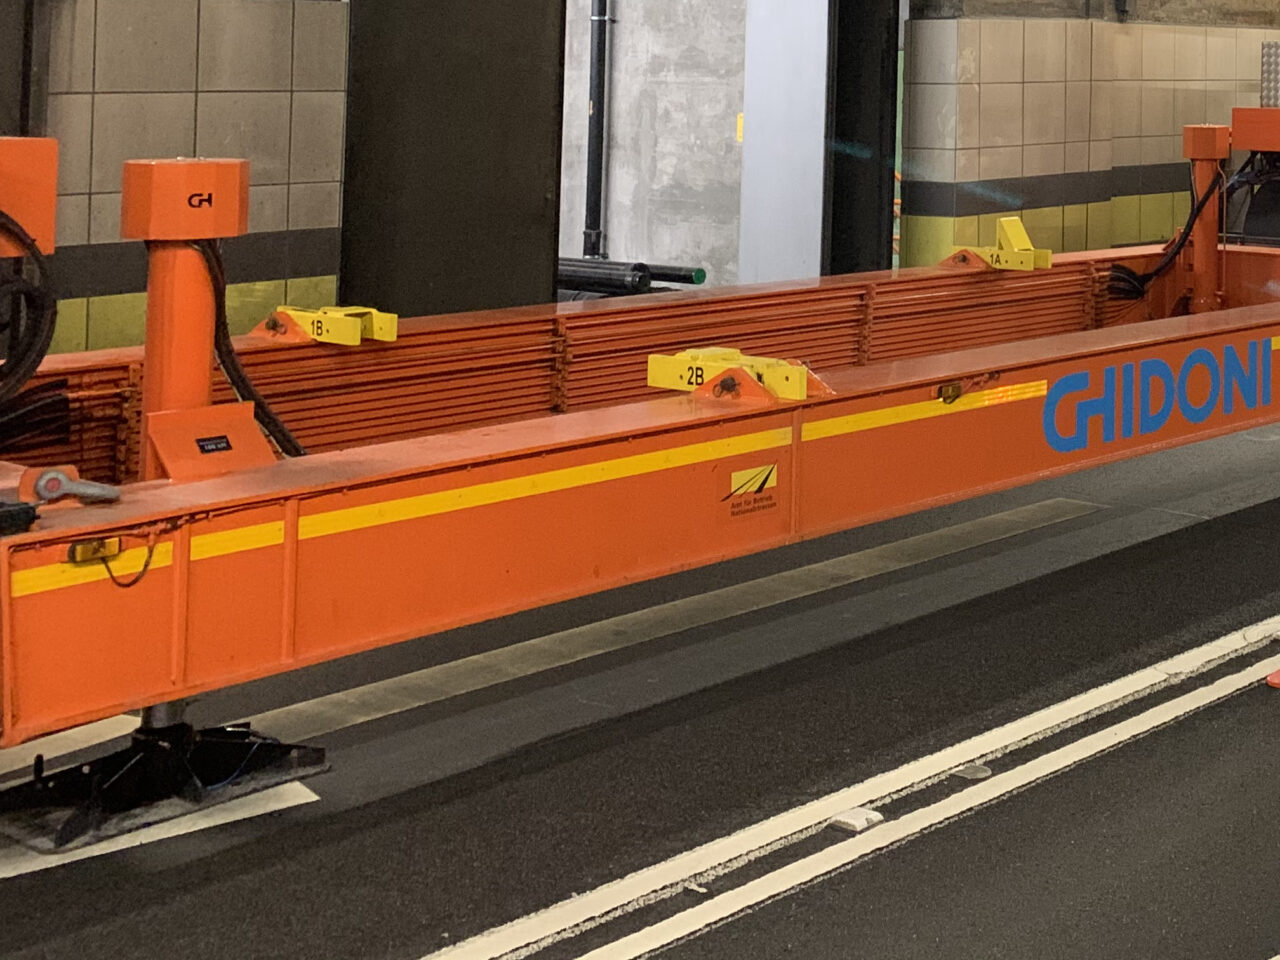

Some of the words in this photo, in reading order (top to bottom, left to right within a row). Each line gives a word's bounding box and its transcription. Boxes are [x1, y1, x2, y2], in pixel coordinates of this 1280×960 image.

[990, 253, 1002, 267] 1A
[311, 320, 323, 337] 1B
[687, 366, 704, 386] 2B
[1043, 337, 1272, 453] GHIDONI
